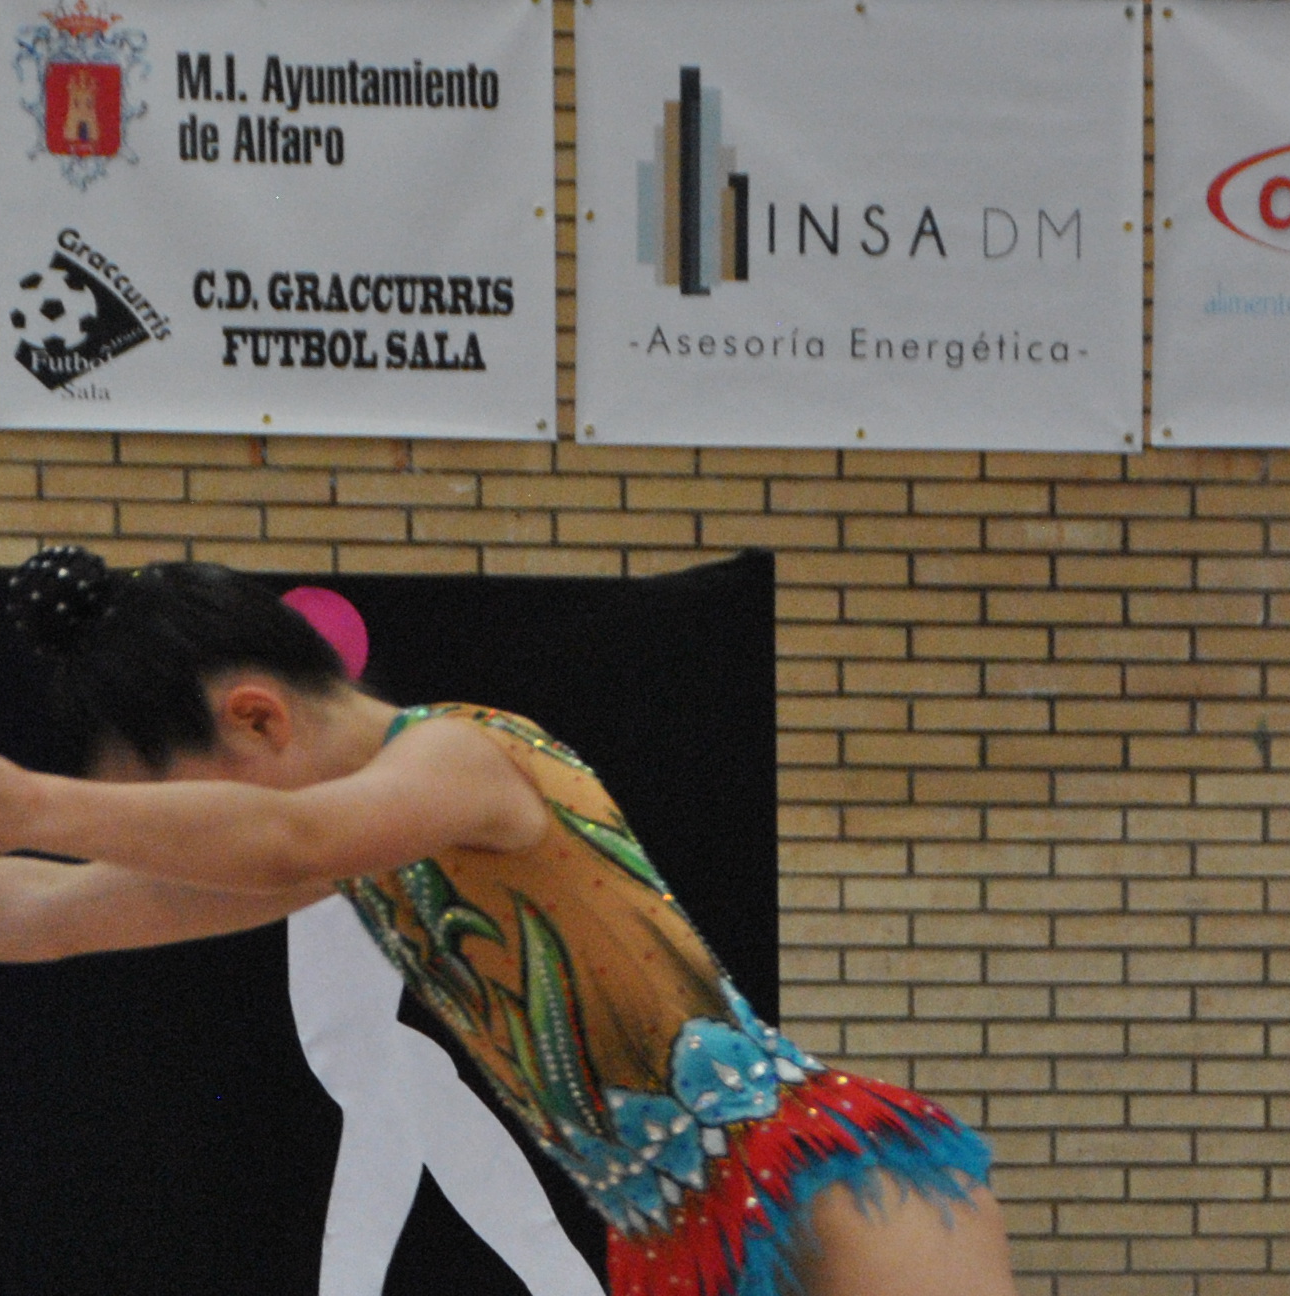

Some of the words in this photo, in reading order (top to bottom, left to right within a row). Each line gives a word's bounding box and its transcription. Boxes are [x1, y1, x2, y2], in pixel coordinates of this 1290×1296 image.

[176, 52, 247, 103] M.I.
[262, 55, 499, 111] Ayuntamiento
[179, 116, 220, 162] de
[234, 116, 345, 165] Alfaro
[767, 203, 948, 258] INSA
[981, 208, 1083, 260] DM
[58, 228, 172, 341] Graccurris
[193, 270, 258, 311] C.D.
[267, 272, 515, 318] GRACCURRIS
[222, 326, 378, 369] FUTBOL
[385, 329, 487, 371] SALA
